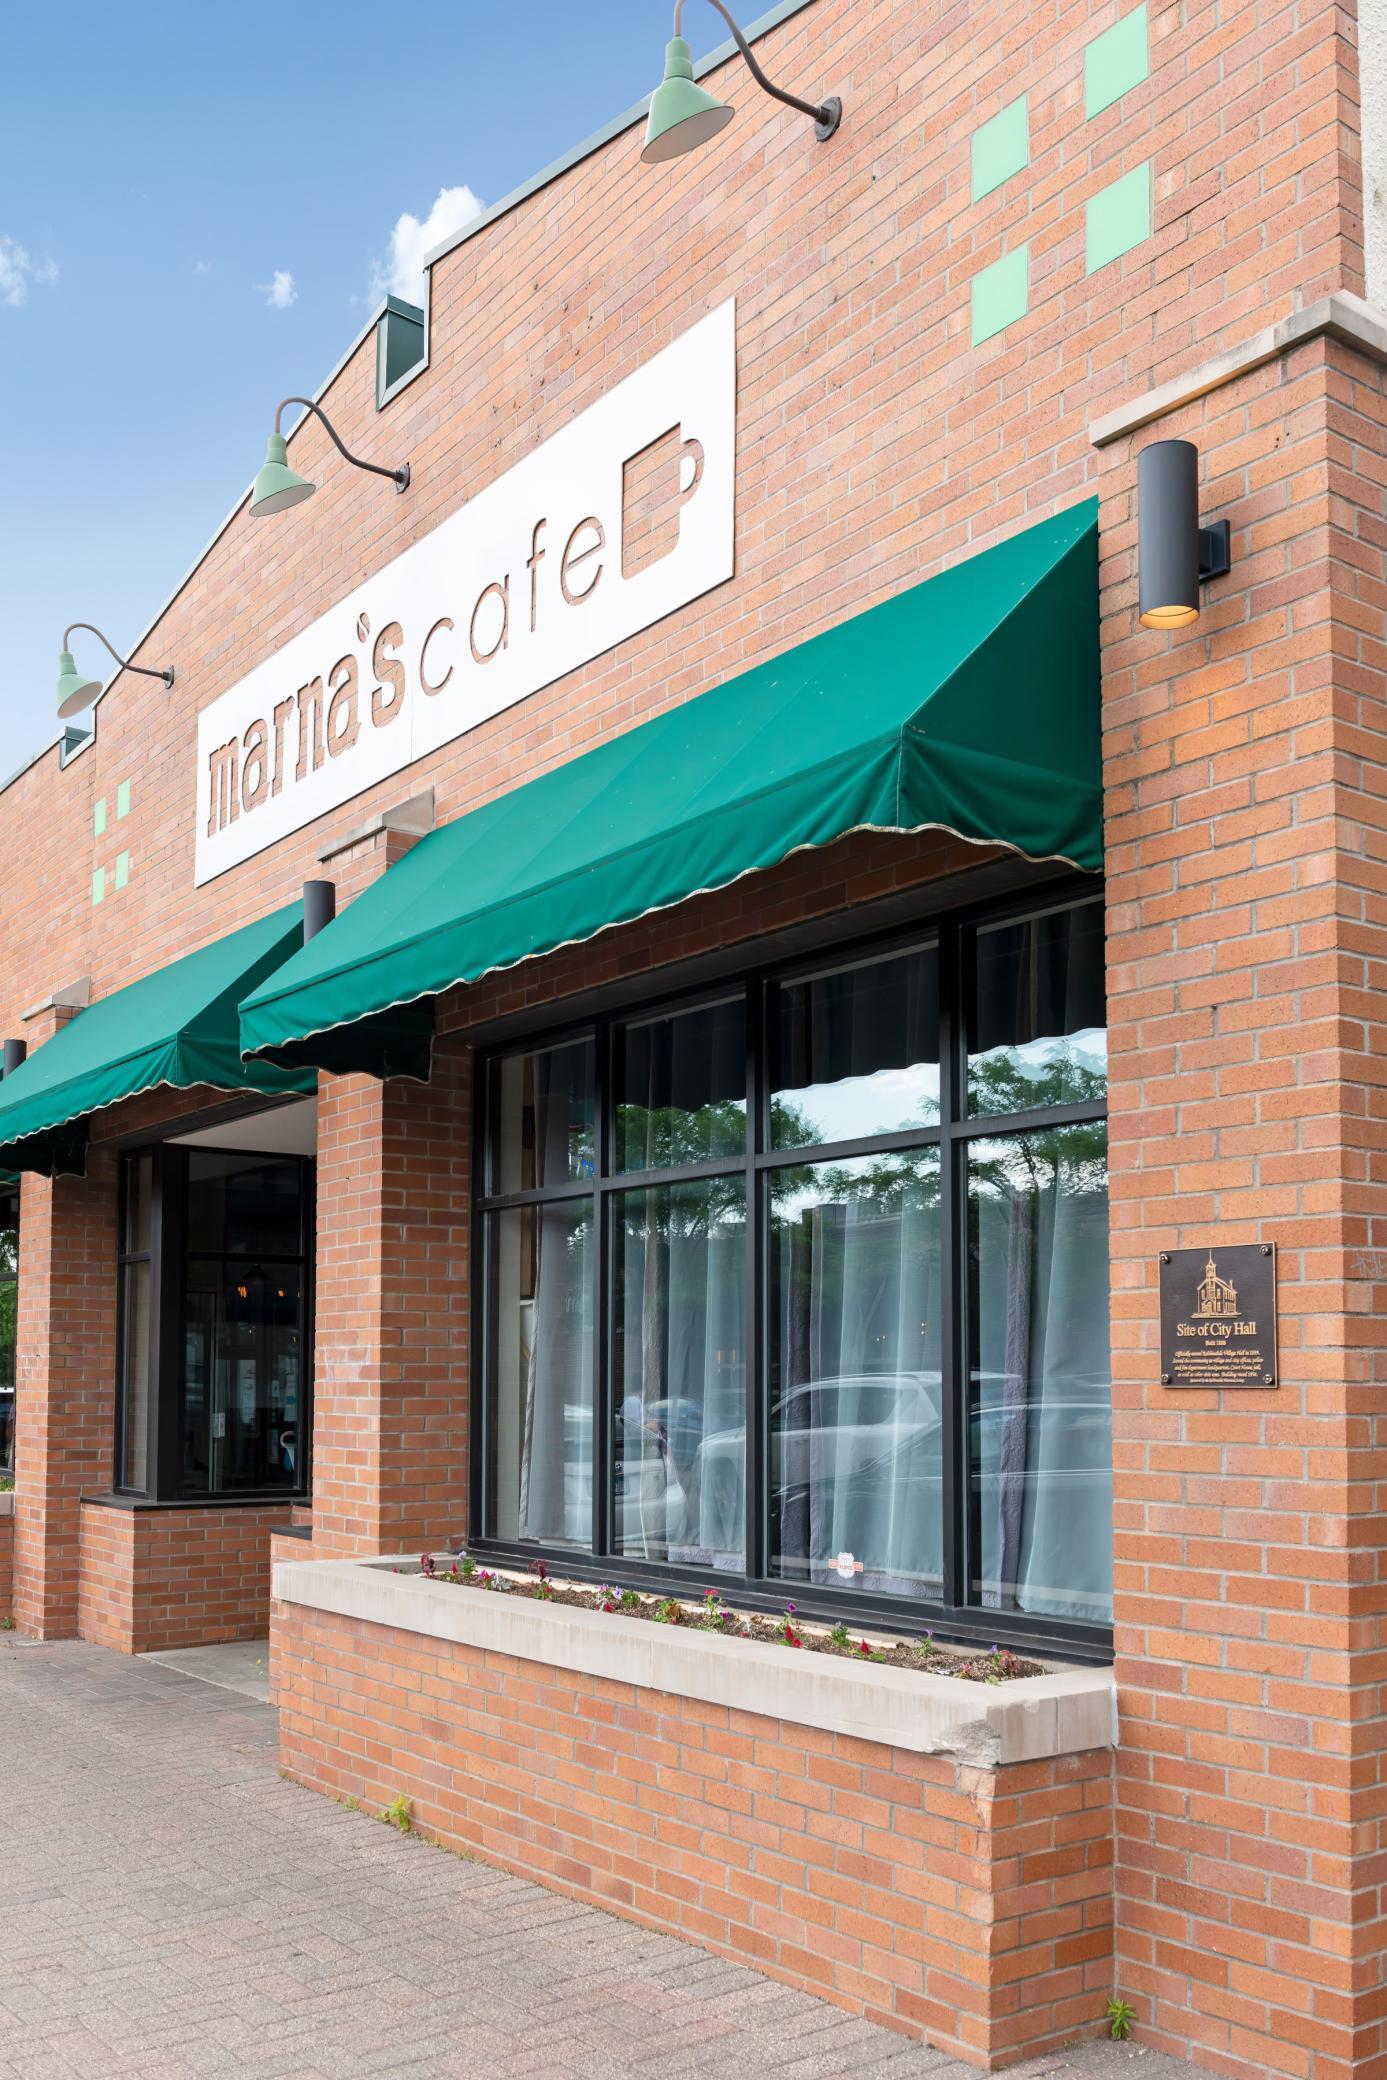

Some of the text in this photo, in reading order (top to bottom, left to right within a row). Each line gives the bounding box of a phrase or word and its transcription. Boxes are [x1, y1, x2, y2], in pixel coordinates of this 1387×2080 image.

[419, 516, 606, 697] cafe
[1177, 1321, 1257, 1338] Site of City Hall
